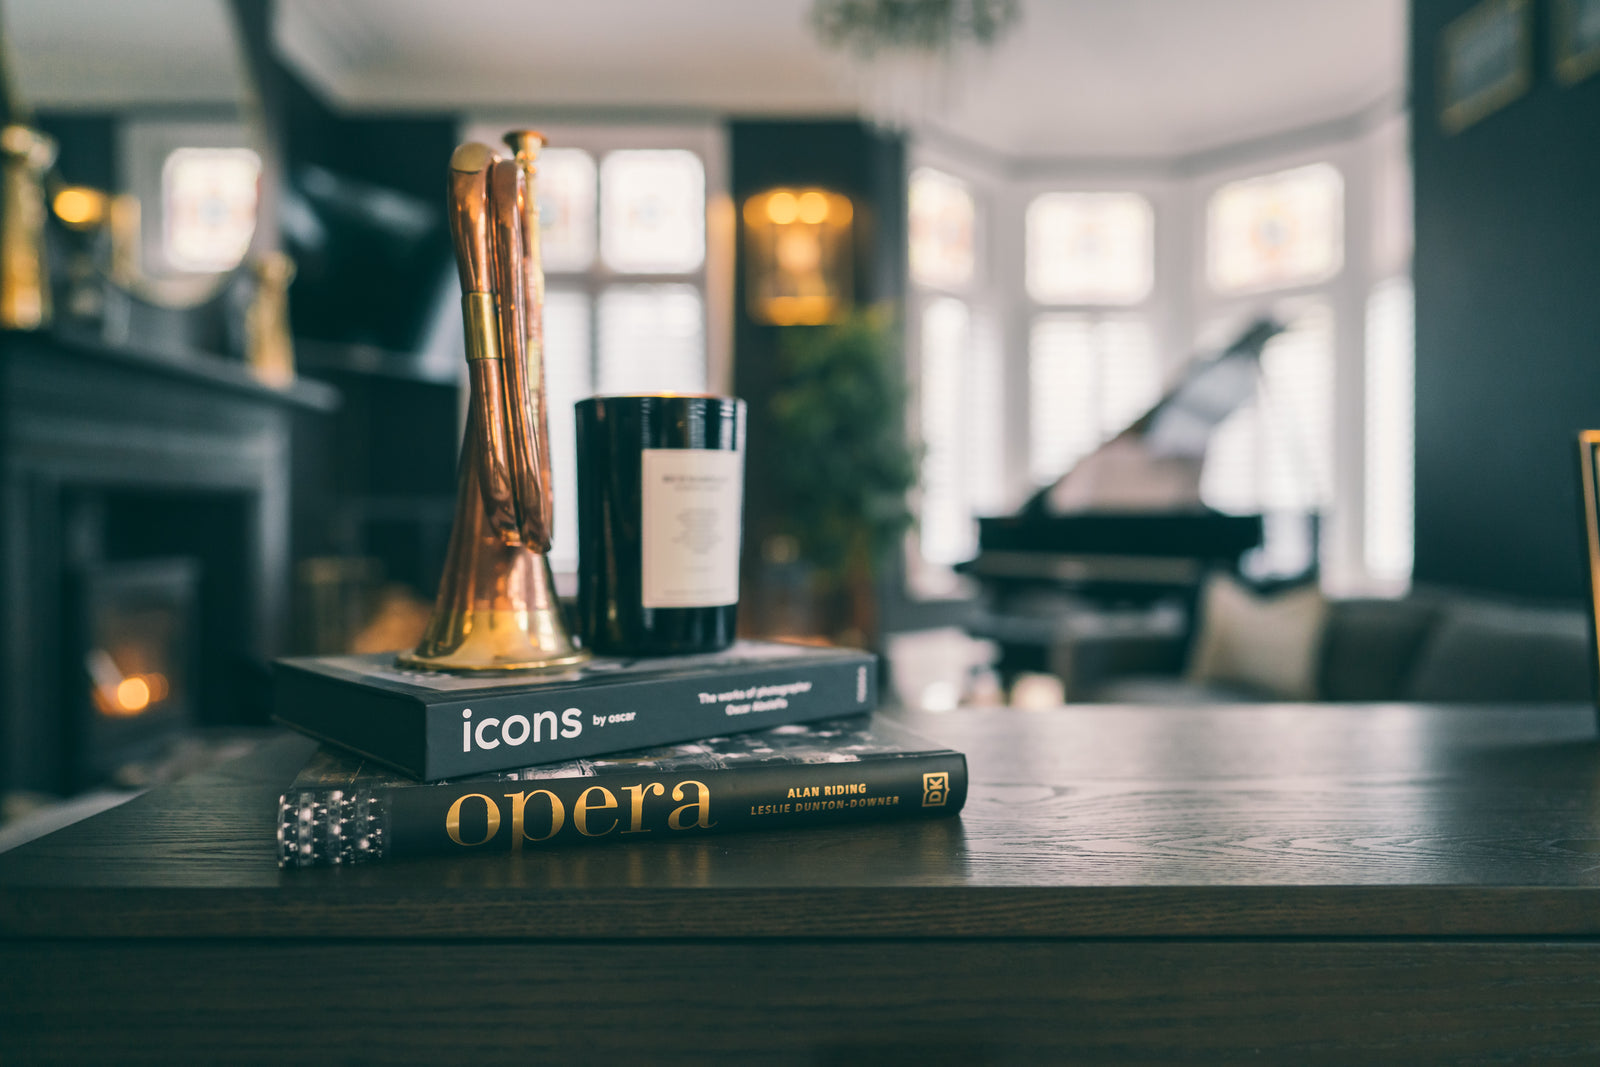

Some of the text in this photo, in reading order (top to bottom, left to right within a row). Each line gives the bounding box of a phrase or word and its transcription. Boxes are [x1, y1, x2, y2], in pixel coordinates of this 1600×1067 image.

[698, 692, 717, 704] The
[717, 690, 745, 702] works
[746, 687, 756, 699] of
[462, 708, 637, 753] icons by oscar
[787, 783, 867, 799] ALAN RIDING
[927, 776, 945, 803] DK
[446, 780, 718, 850] opera
[751, 796, 900, 816] LESLIE DUNTON-DOWNER
